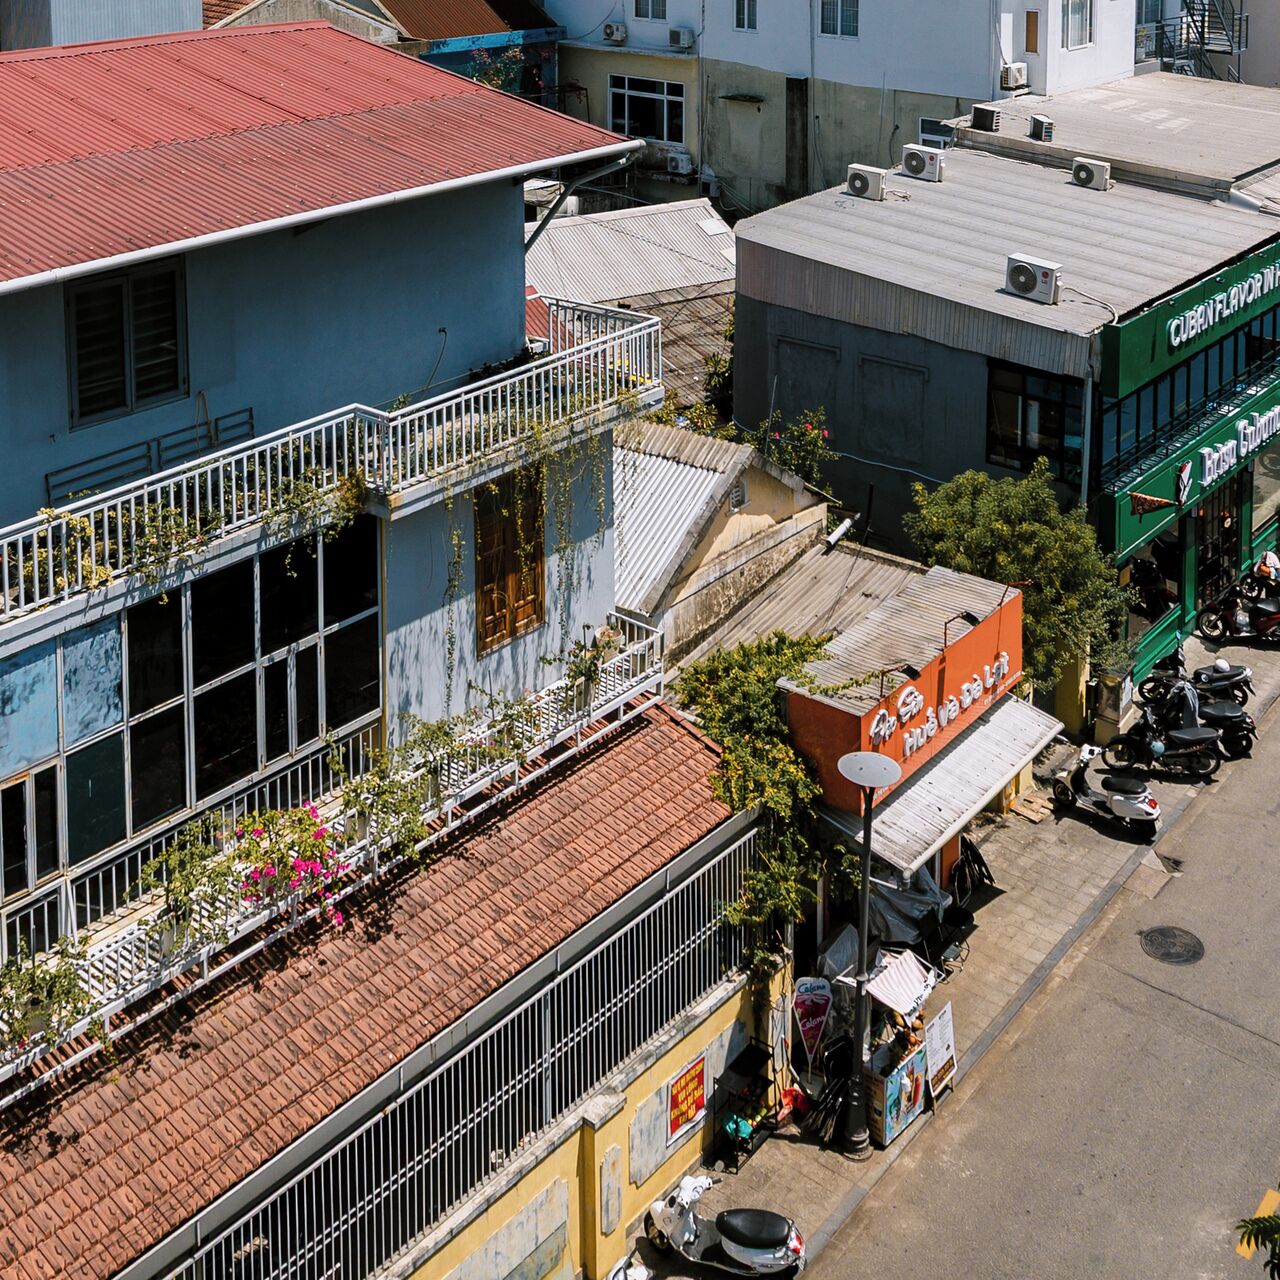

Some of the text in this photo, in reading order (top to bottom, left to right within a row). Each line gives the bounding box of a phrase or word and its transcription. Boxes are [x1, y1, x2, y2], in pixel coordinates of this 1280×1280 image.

[1168, 299, 1215, 348] CUBAN
[1214, 272, 1263, 322] FLAVOR
[1262, 264, 1276, 296] IN
[1198, 438, 1238, 488] Brisa
